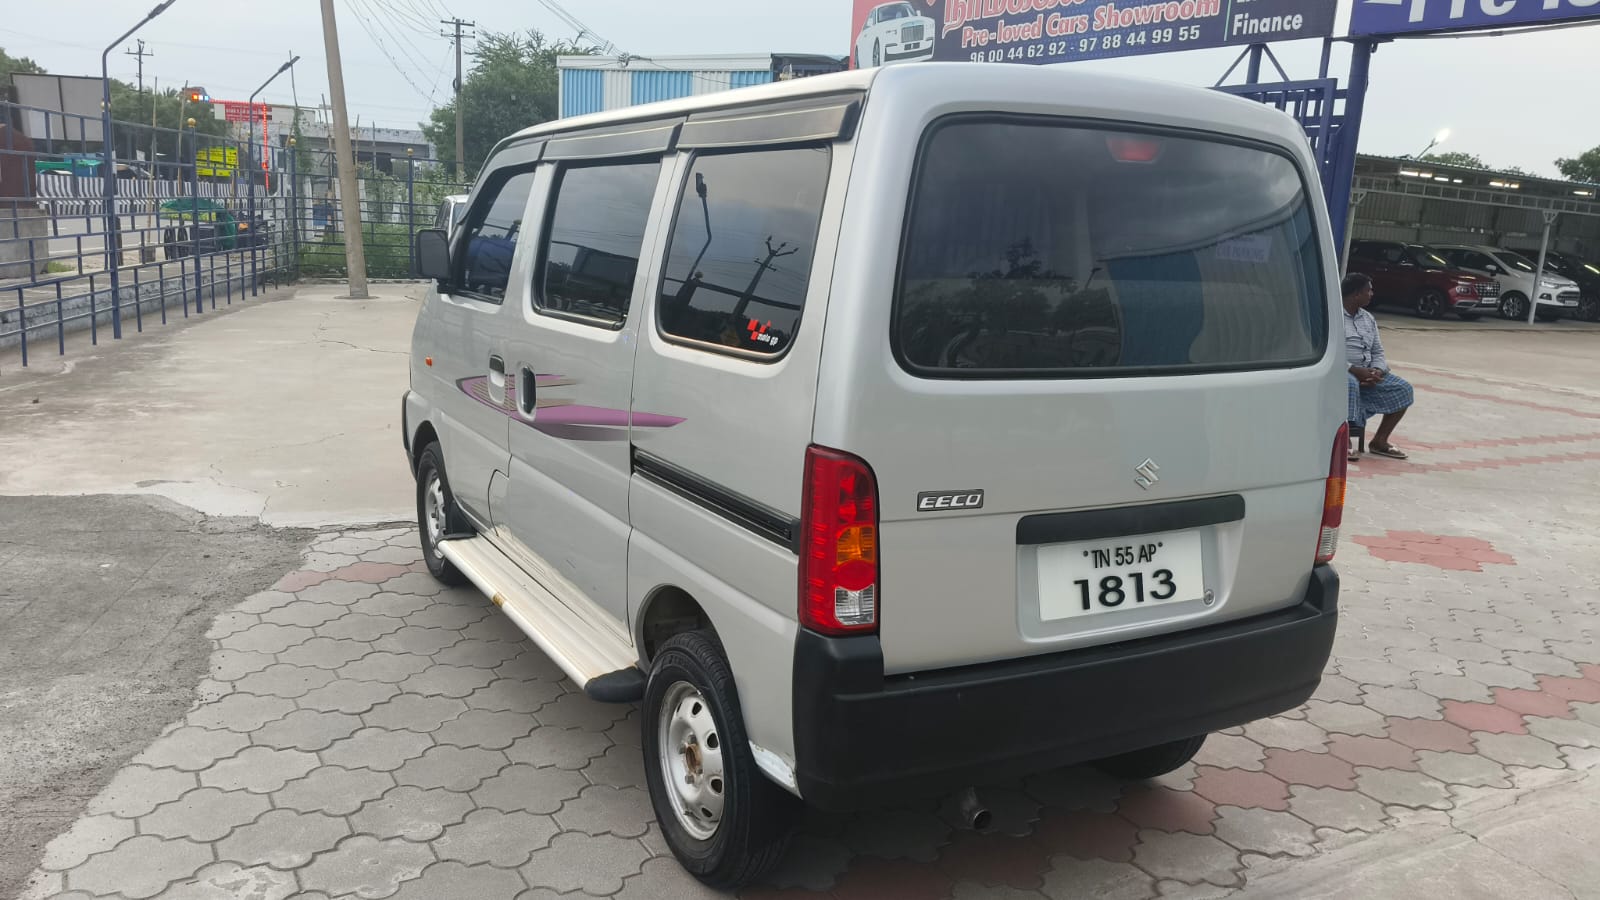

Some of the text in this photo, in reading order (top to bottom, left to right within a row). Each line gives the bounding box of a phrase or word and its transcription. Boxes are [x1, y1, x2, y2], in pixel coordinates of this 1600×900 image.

[962, 14, 1043, 48] Pre-loved
[1046, 12, 1089, 37] Cars
[1093, 0, 1221, 31] Showroom
[1232, 13, 1303, 36] Finance
[970, 51, 984, 63] 96
[989, 49, 1004, 62] 00
[1007, 47, 1023, 60] 44
[1028, 44, 1044, 58] 62
[1049, 41, 1066, 55] 92
[1080, 37, 1097, 52] 97
[1102, 34, 1121, 49] 88
[1126, 31, 1146, 46] 44
[1152, 28, 1172, 43] 99
[1179, 25, 1200, 41] 55
[919, 494, 982, 509] EECO
[1092, 543, 1157, 569] TN 55 AP
[1073, 568, 1177, 611] 1813
